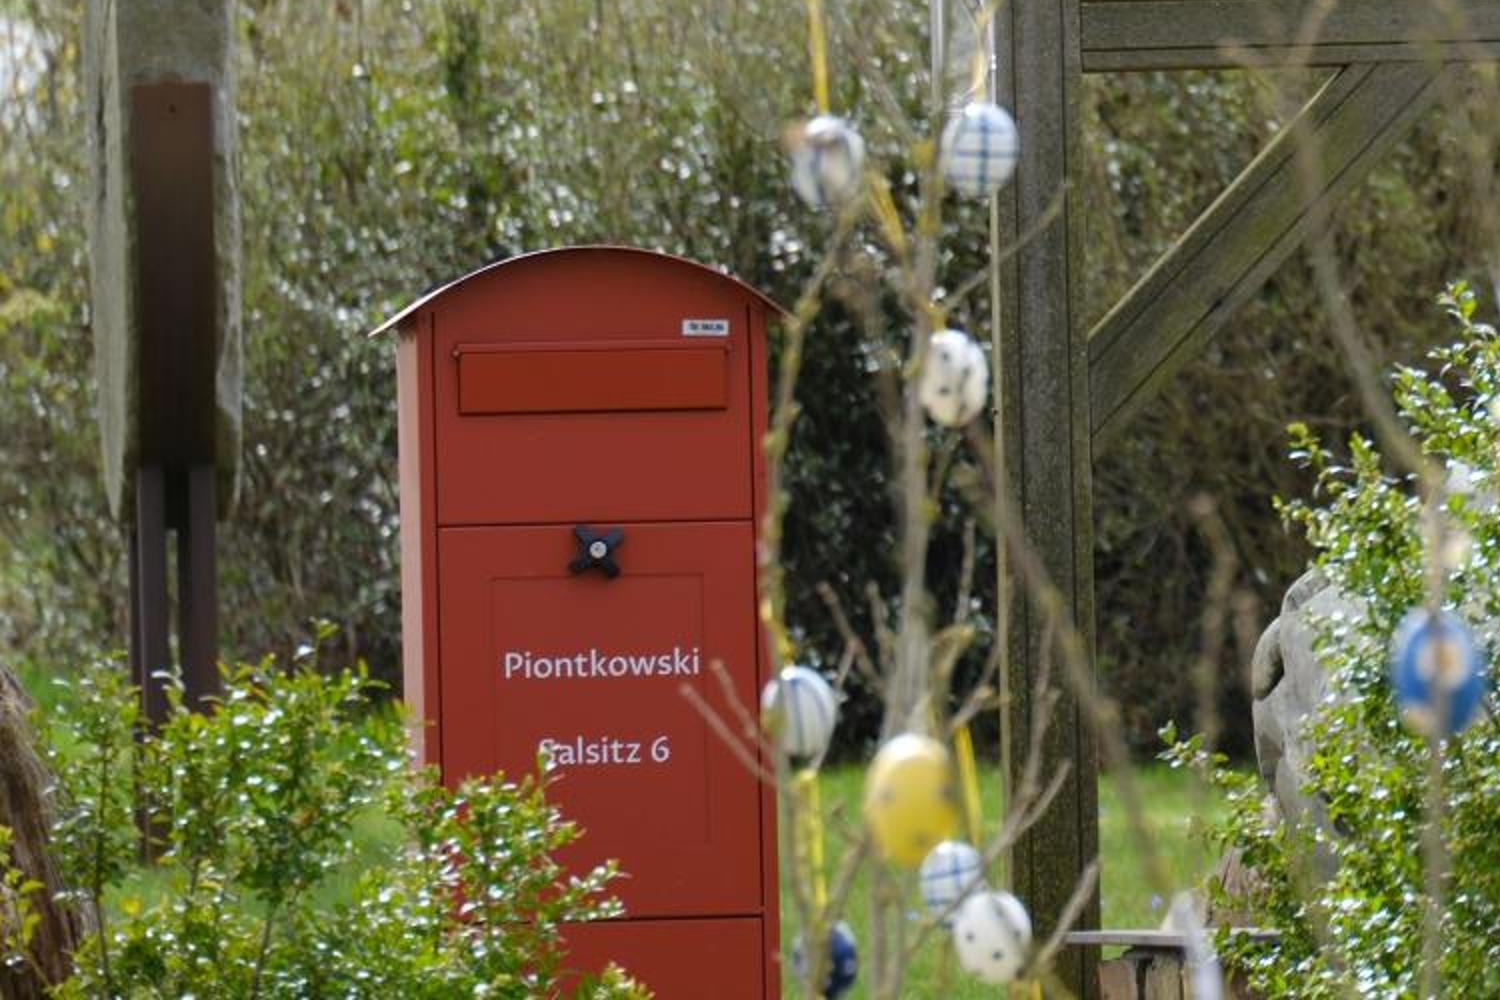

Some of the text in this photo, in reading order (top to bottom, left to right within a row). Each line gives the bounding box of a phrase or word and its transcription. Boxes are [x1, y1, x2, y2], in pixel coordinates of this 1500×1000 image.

[504, 648, 699, 679] Piontkowski
[539, 735, 670, 765] Salsitz 6
